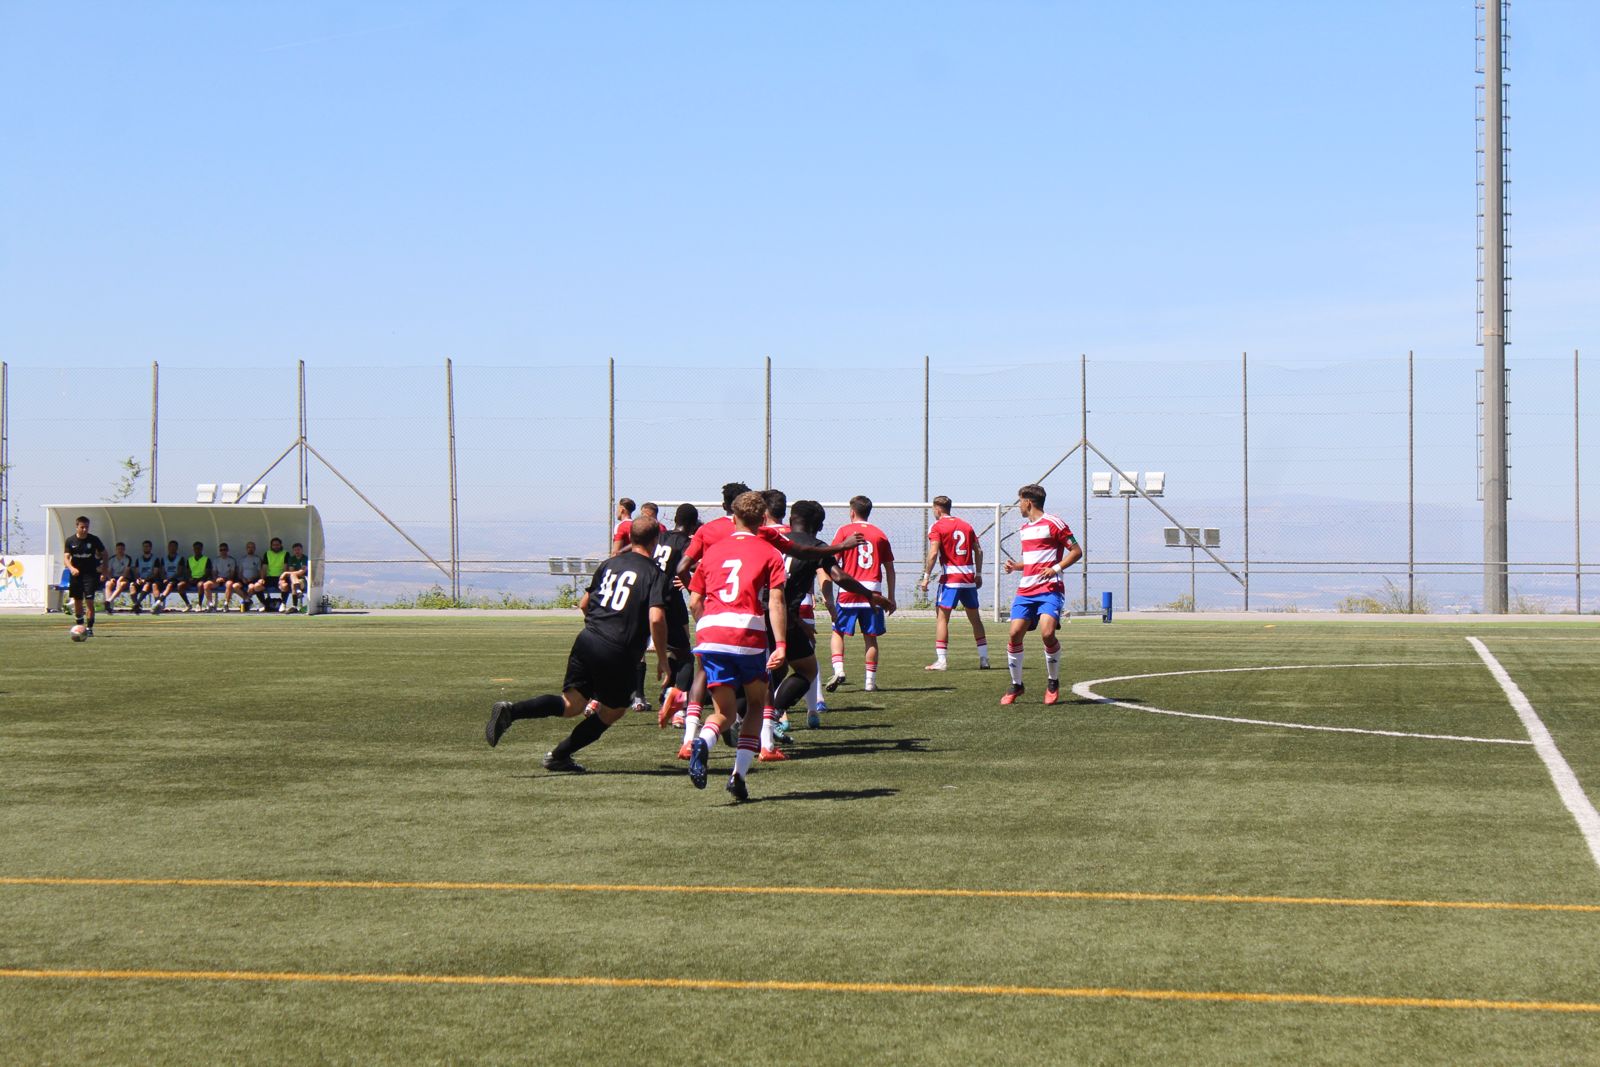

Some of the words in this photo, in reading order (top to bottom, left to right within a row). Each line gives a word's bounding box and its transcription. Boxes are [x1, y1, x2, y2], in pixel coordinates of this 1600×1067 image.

[857, 540, 873, 569] 8
[953, 530, 967, 555] 2
[598, 568, 637, 611] 46
[719, 559, 742, 603] 3
